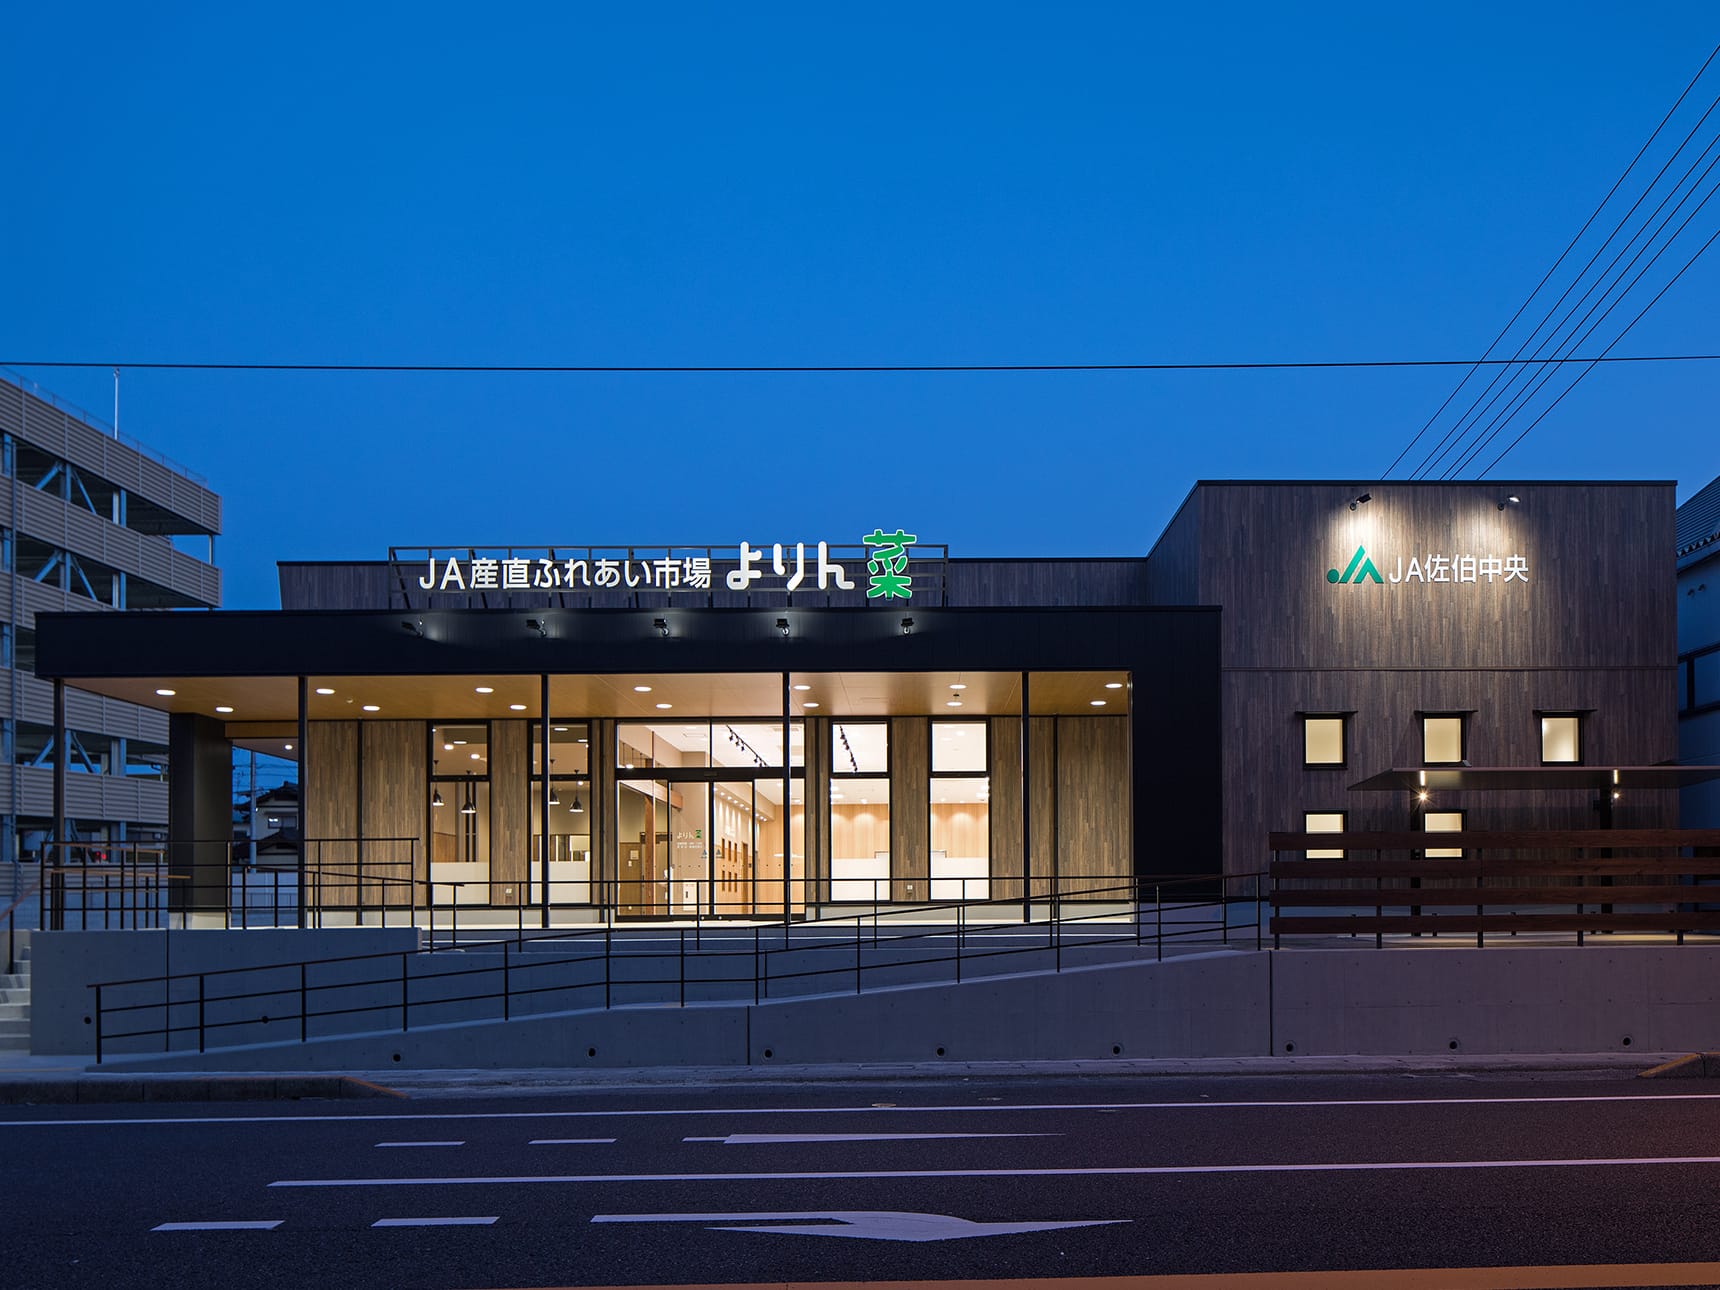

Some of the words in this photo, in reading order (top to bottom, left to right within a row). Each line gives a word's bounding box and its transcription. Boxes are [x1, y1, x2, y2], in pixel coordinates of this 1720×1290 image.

[419, 557, 712, 590] JA産直ふれあい市場
[727, 529, 917, 599] よりん菜
[1389, 554, 1529, 583] JA佐伯中央
